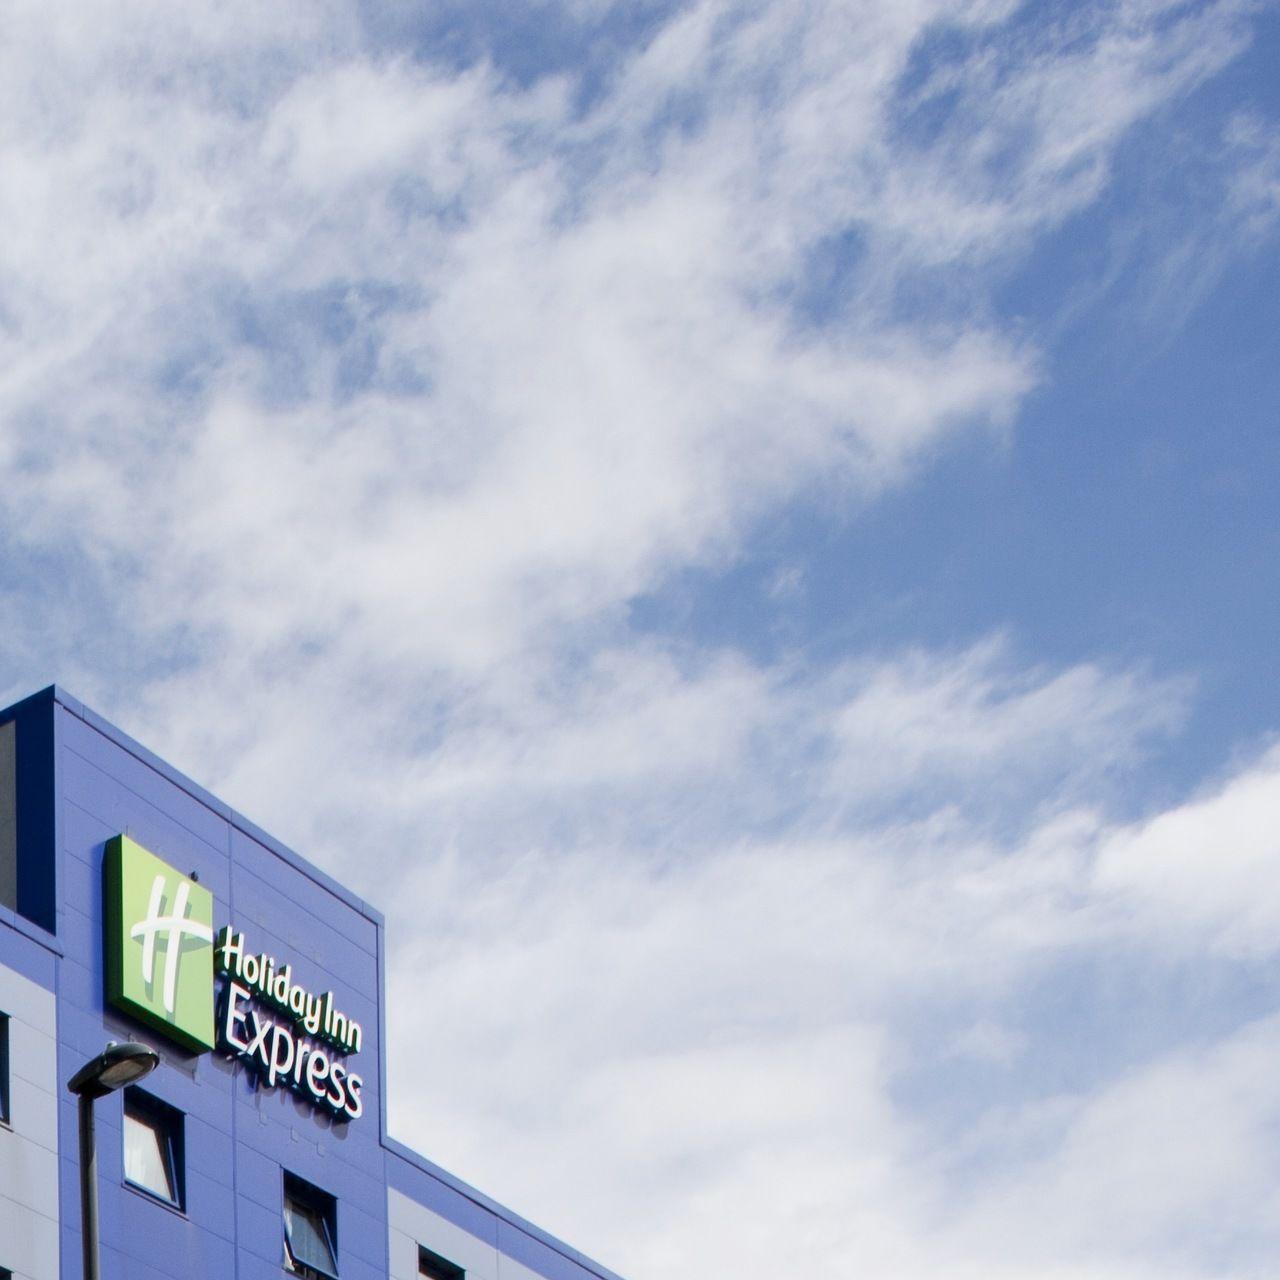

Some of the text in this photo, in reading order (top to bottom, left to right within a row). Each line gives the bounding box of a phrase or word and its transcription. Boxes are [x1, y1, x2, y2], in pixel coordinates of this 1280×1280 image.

[216, 924, 363, 1053] Holiday Inn
[224, 981, 364, 1120] Express
